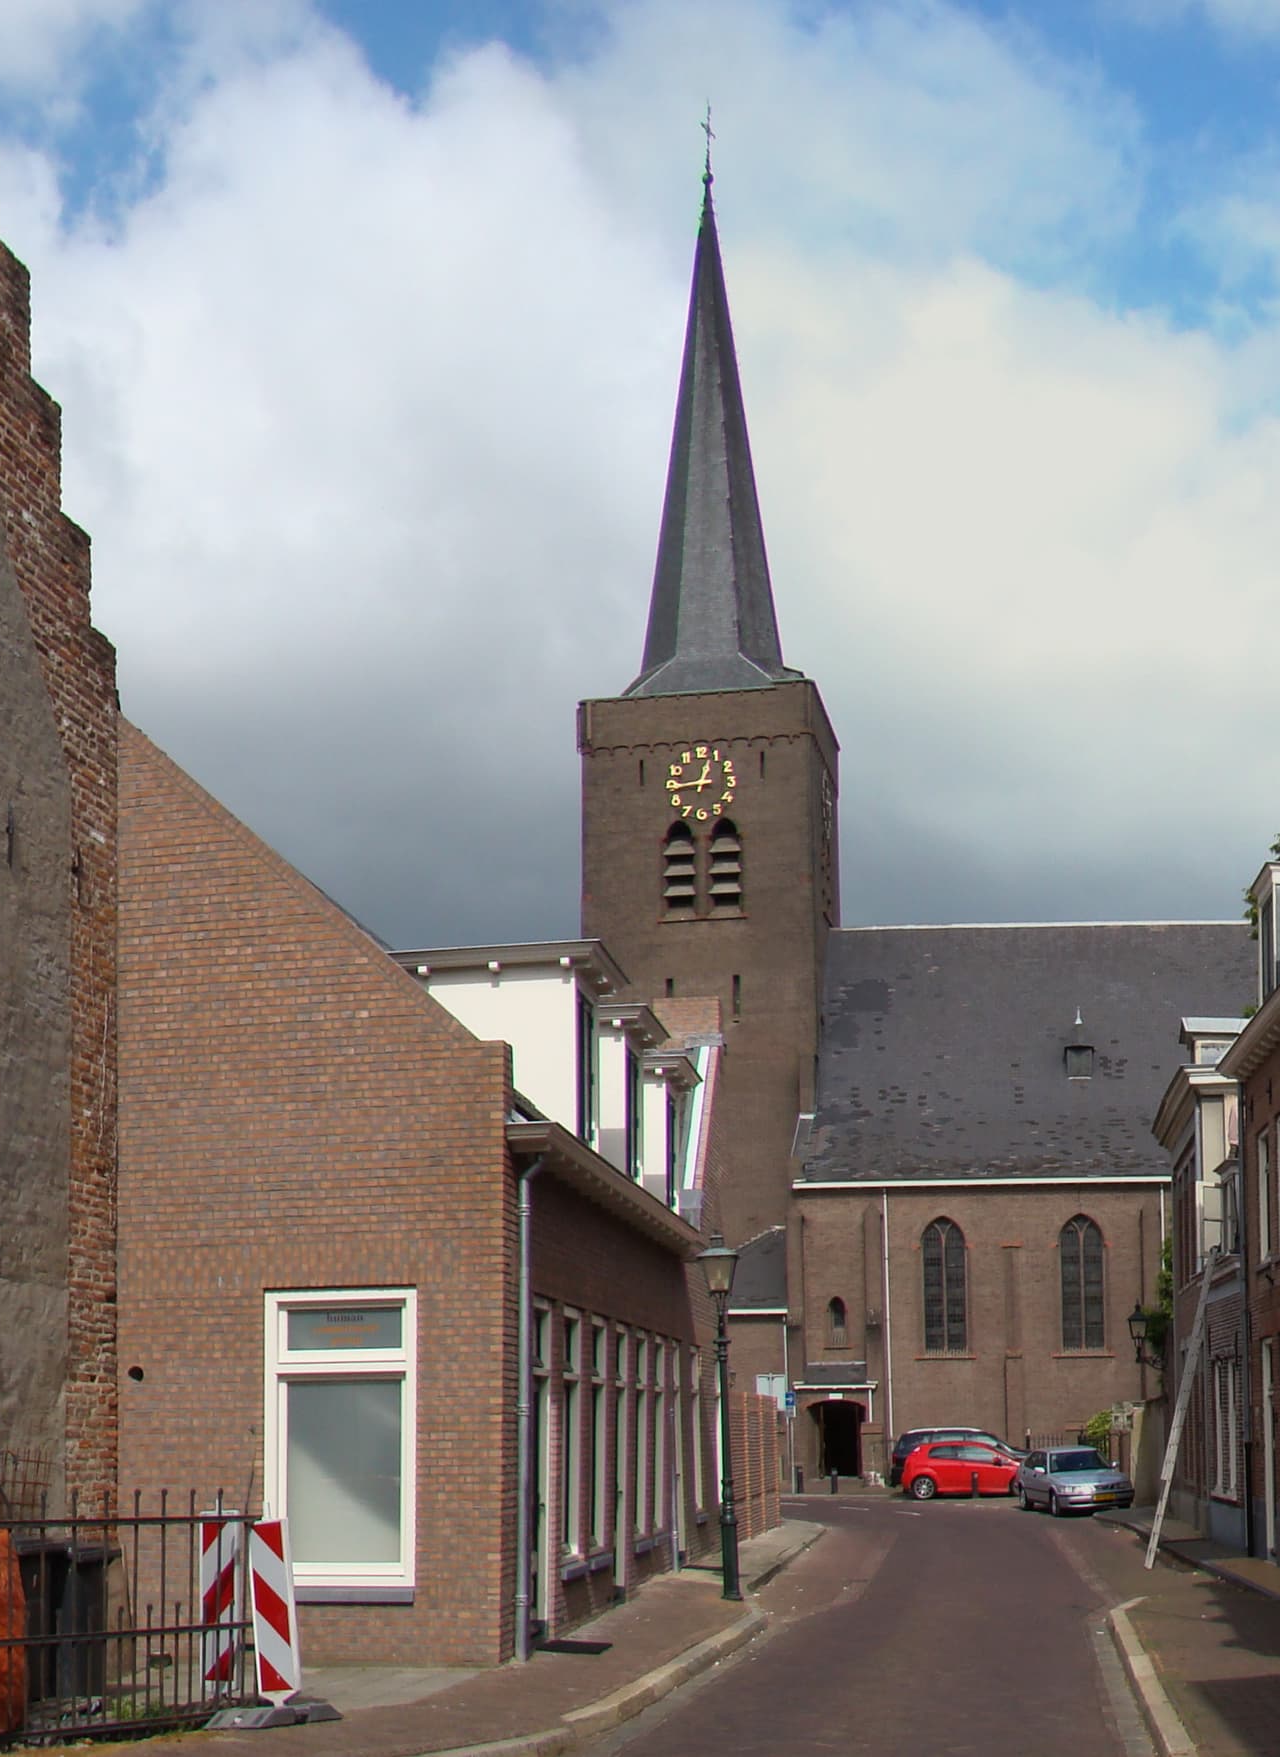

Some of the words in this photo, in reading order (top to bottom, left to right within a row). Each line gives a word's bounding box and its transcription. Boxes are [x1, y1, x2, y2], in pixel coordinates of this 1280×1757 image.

[681, 752, 691, 764] 11
[695, 746, 707, 758] 12
[713, 750, 719, 761] 1
[669, 764, 682, 776] 10
[723, 760, 733, 773] 2
[726, 776, 736, 788] 3
[671, 794, 681, 806] 8
[721, 791, 733, 802] 4
[681, 805, 693, 817] 7
[696, 808, 707, 820] 6
[712, 803, 721, 815] 5
